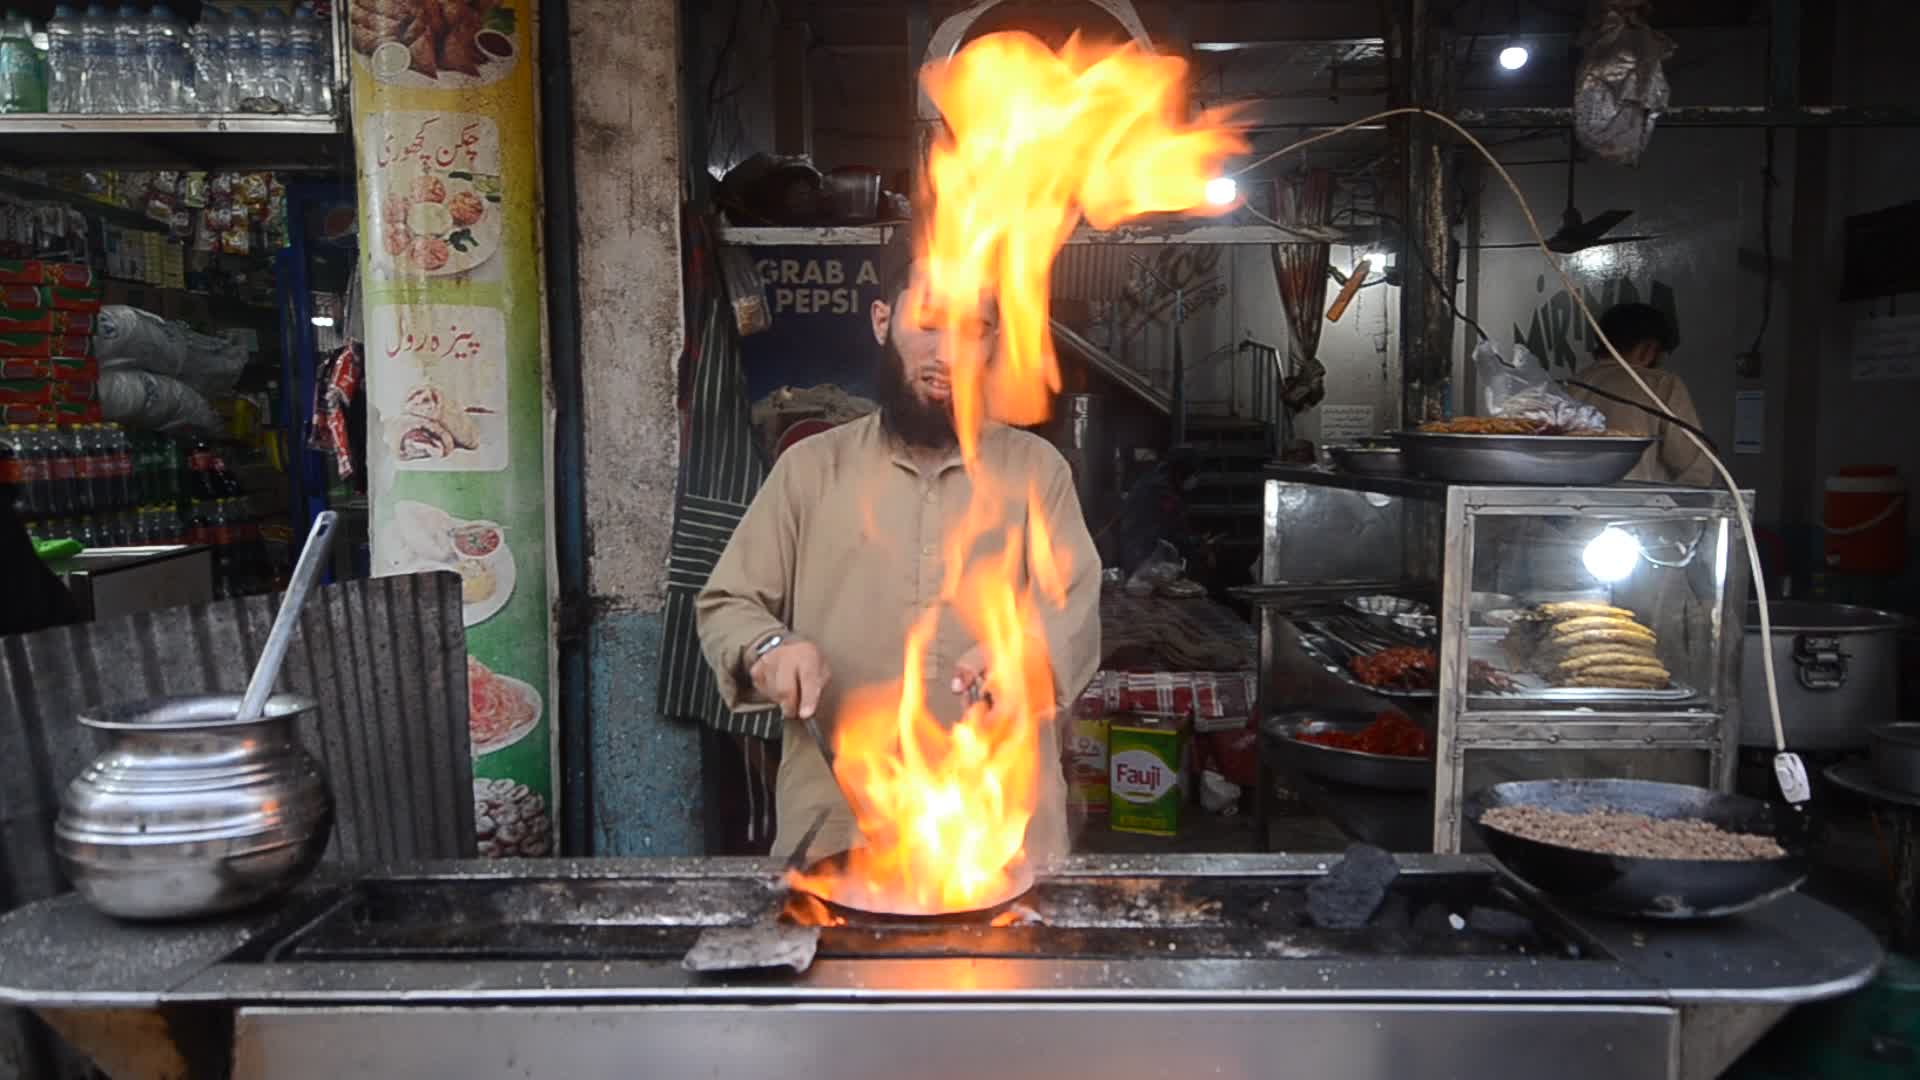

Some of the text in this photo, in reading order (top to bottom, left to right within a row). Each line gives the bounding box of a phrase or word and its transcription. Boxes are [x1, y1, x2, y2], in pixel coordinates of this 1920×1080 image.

[436, 122, 480, 167] چکن
[756, 259, 880, 285] GRAB A
[774, 288, 860, 314] PEPSI
[1116, 763, 1161, 791] Fauji
